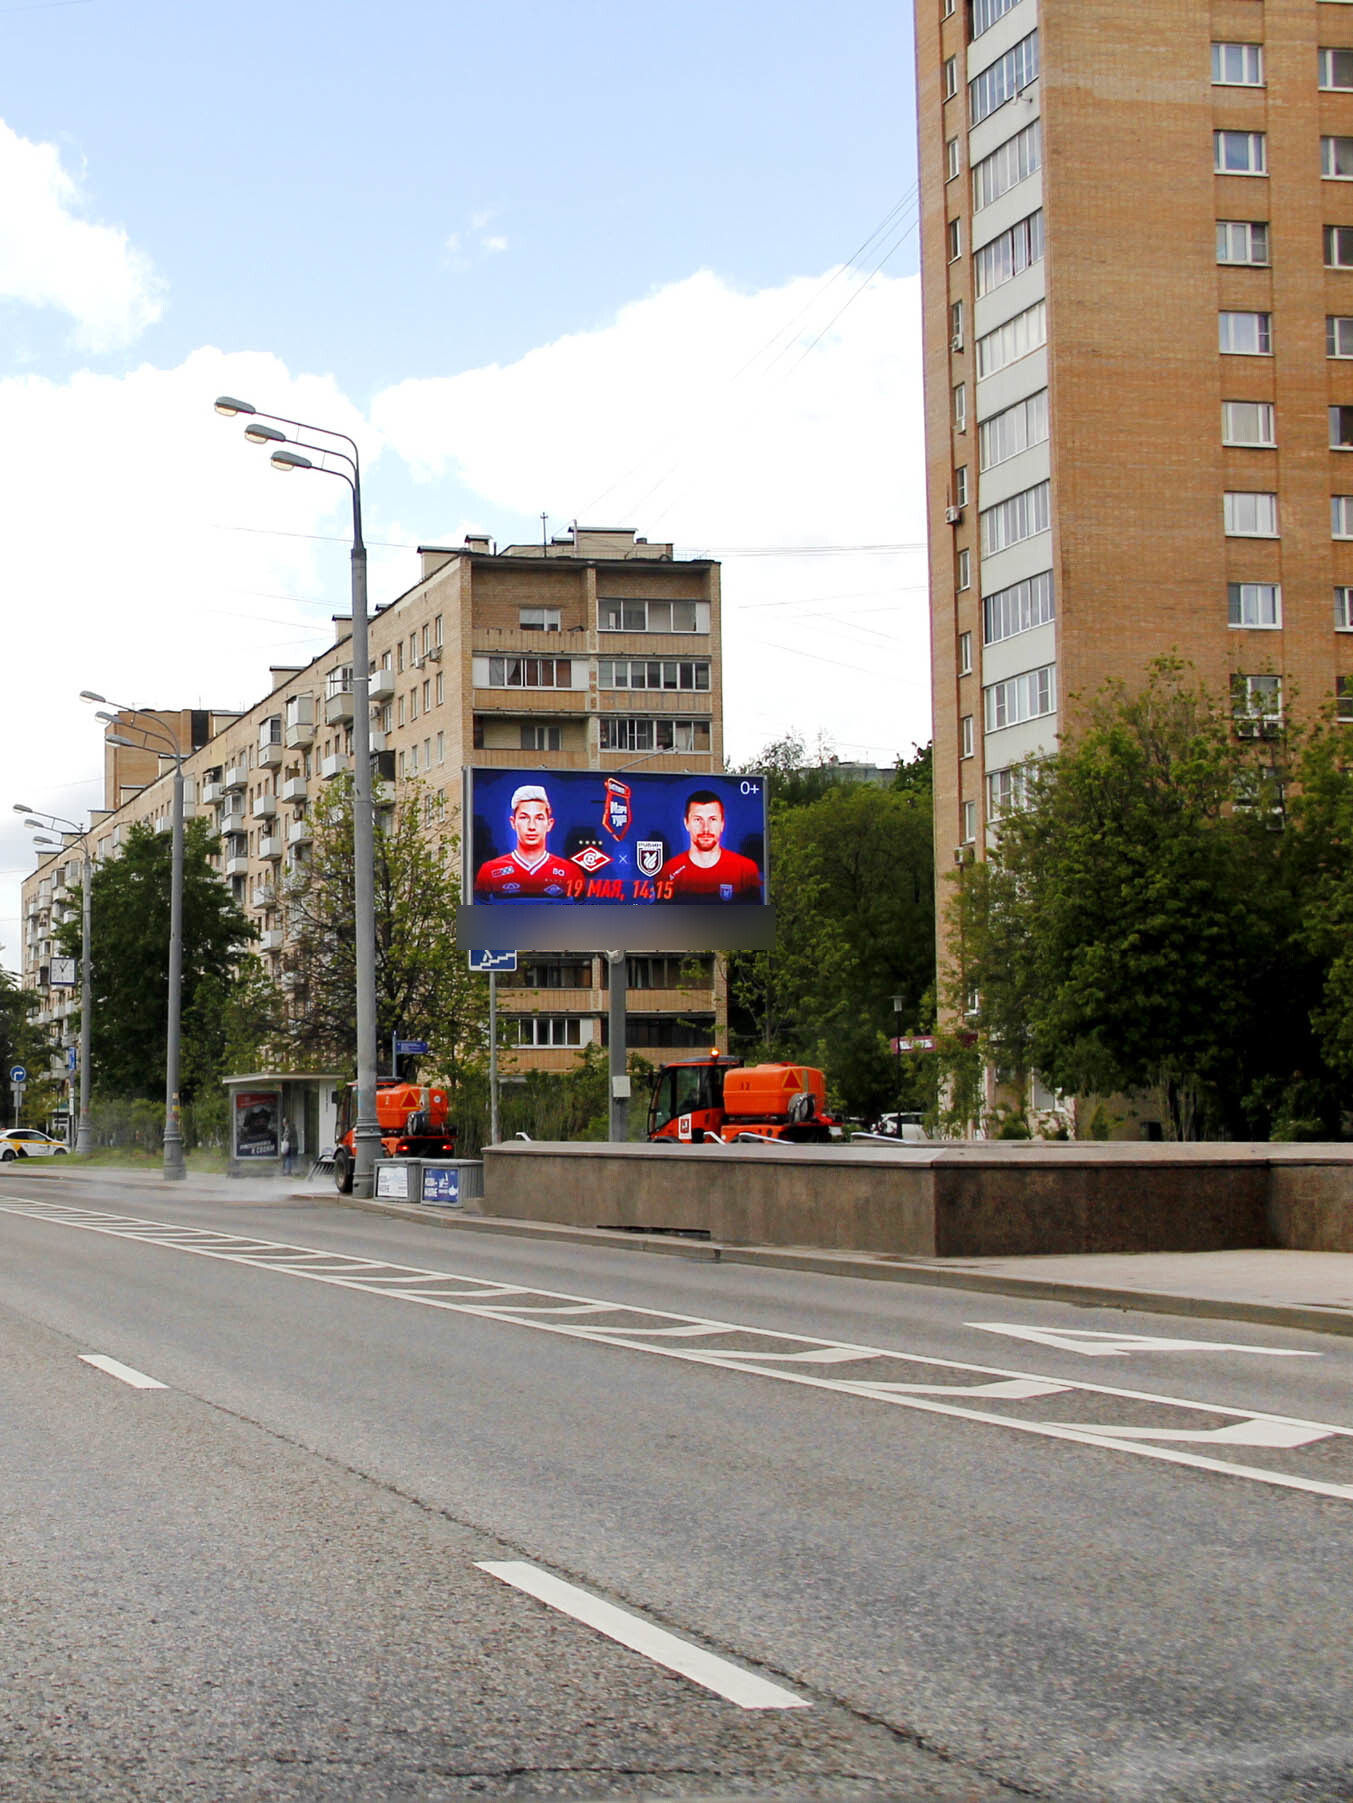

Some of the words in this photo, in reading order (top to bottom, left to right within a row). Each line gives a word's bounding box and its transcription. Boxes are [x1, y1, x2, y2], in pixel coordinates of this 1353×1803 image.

[740, 781, 760, 795] 0+
[566, 879, 584, 897] 19
[587, 879, 625, 901] МАЯ,
[632, 880, 675, 899] 14:15
